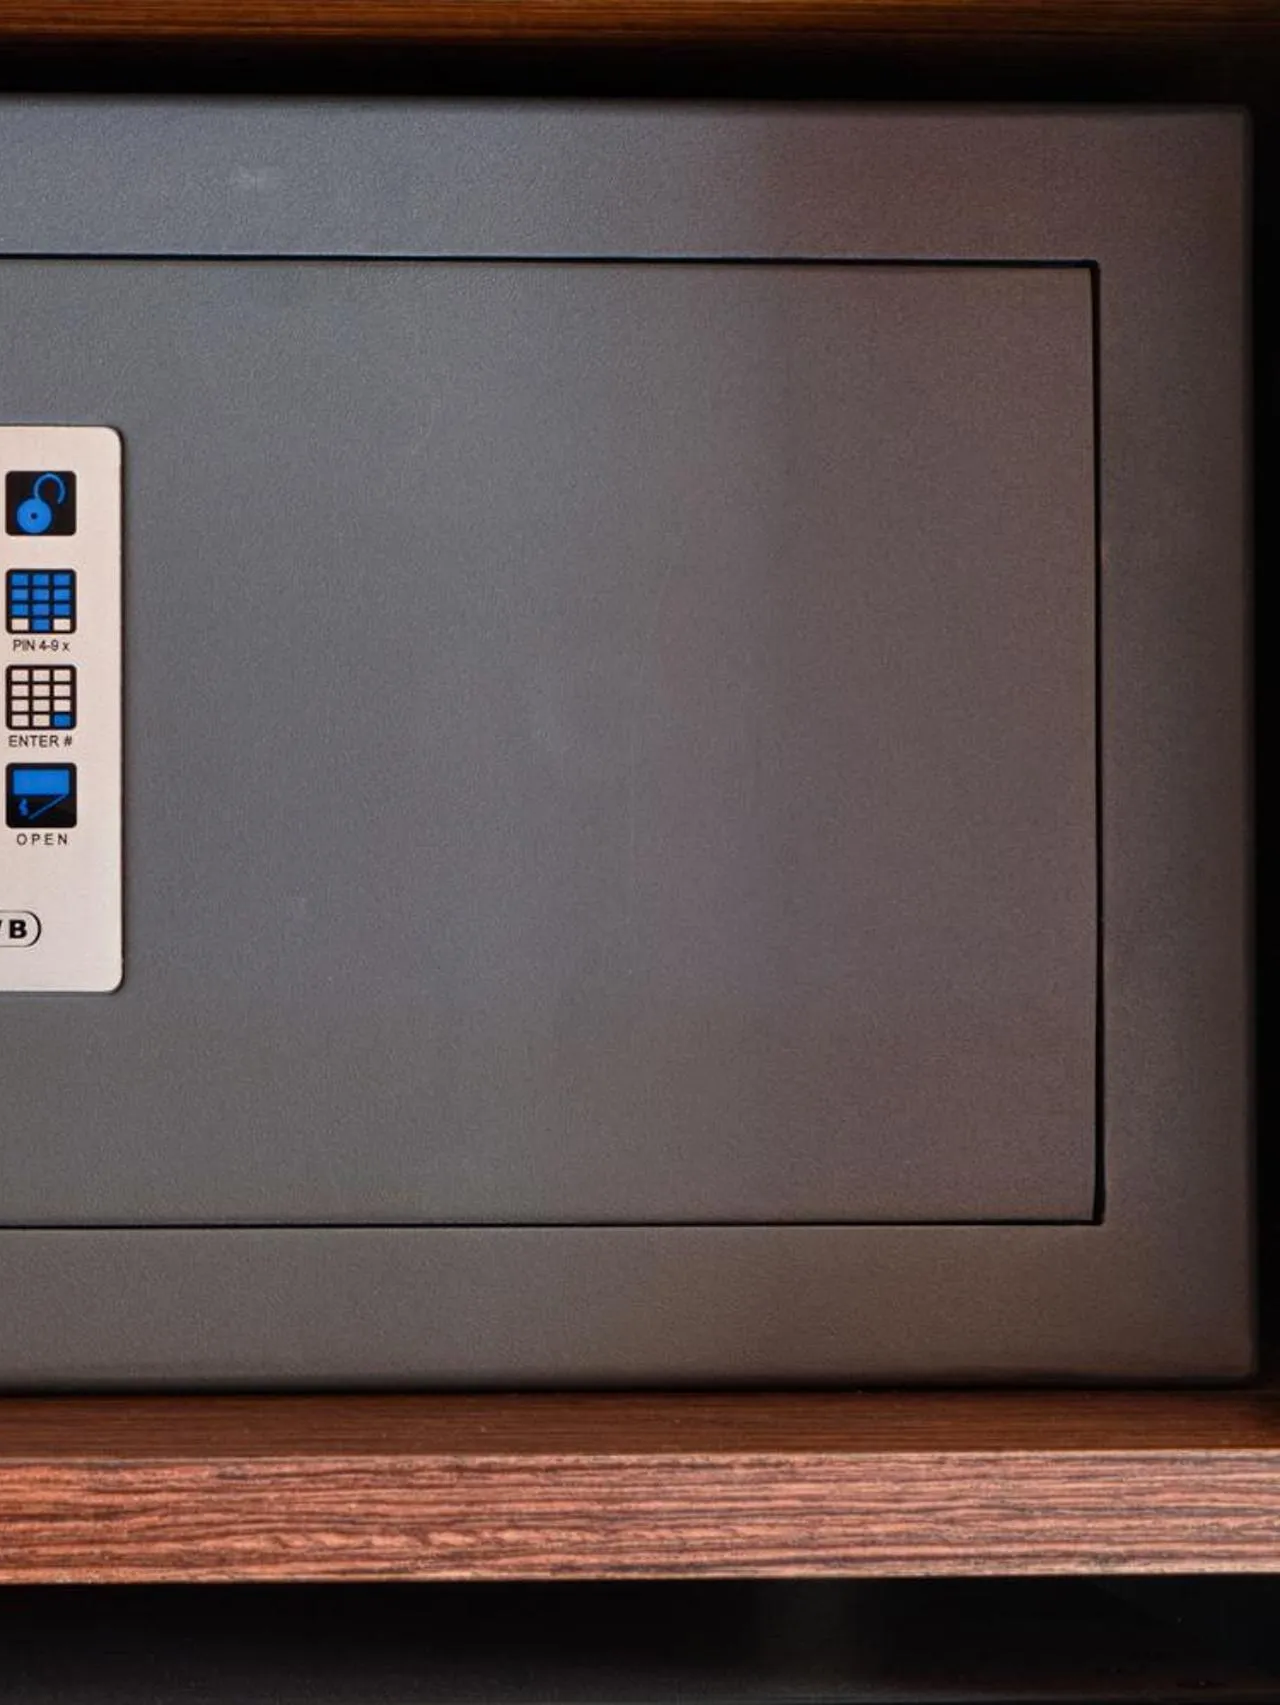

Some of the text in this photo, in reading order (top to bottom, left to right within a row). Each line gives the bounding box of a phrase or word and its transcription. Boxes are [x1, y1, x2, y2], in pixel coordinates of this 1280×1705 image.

[12, 638, 36, 652] PIN
[38, 638, 59, 652] 4-9
[8, 734, 73, 748] ENTER #
[16, 832, 68, 846] OPEN
[9, 920, 29, 940] B
